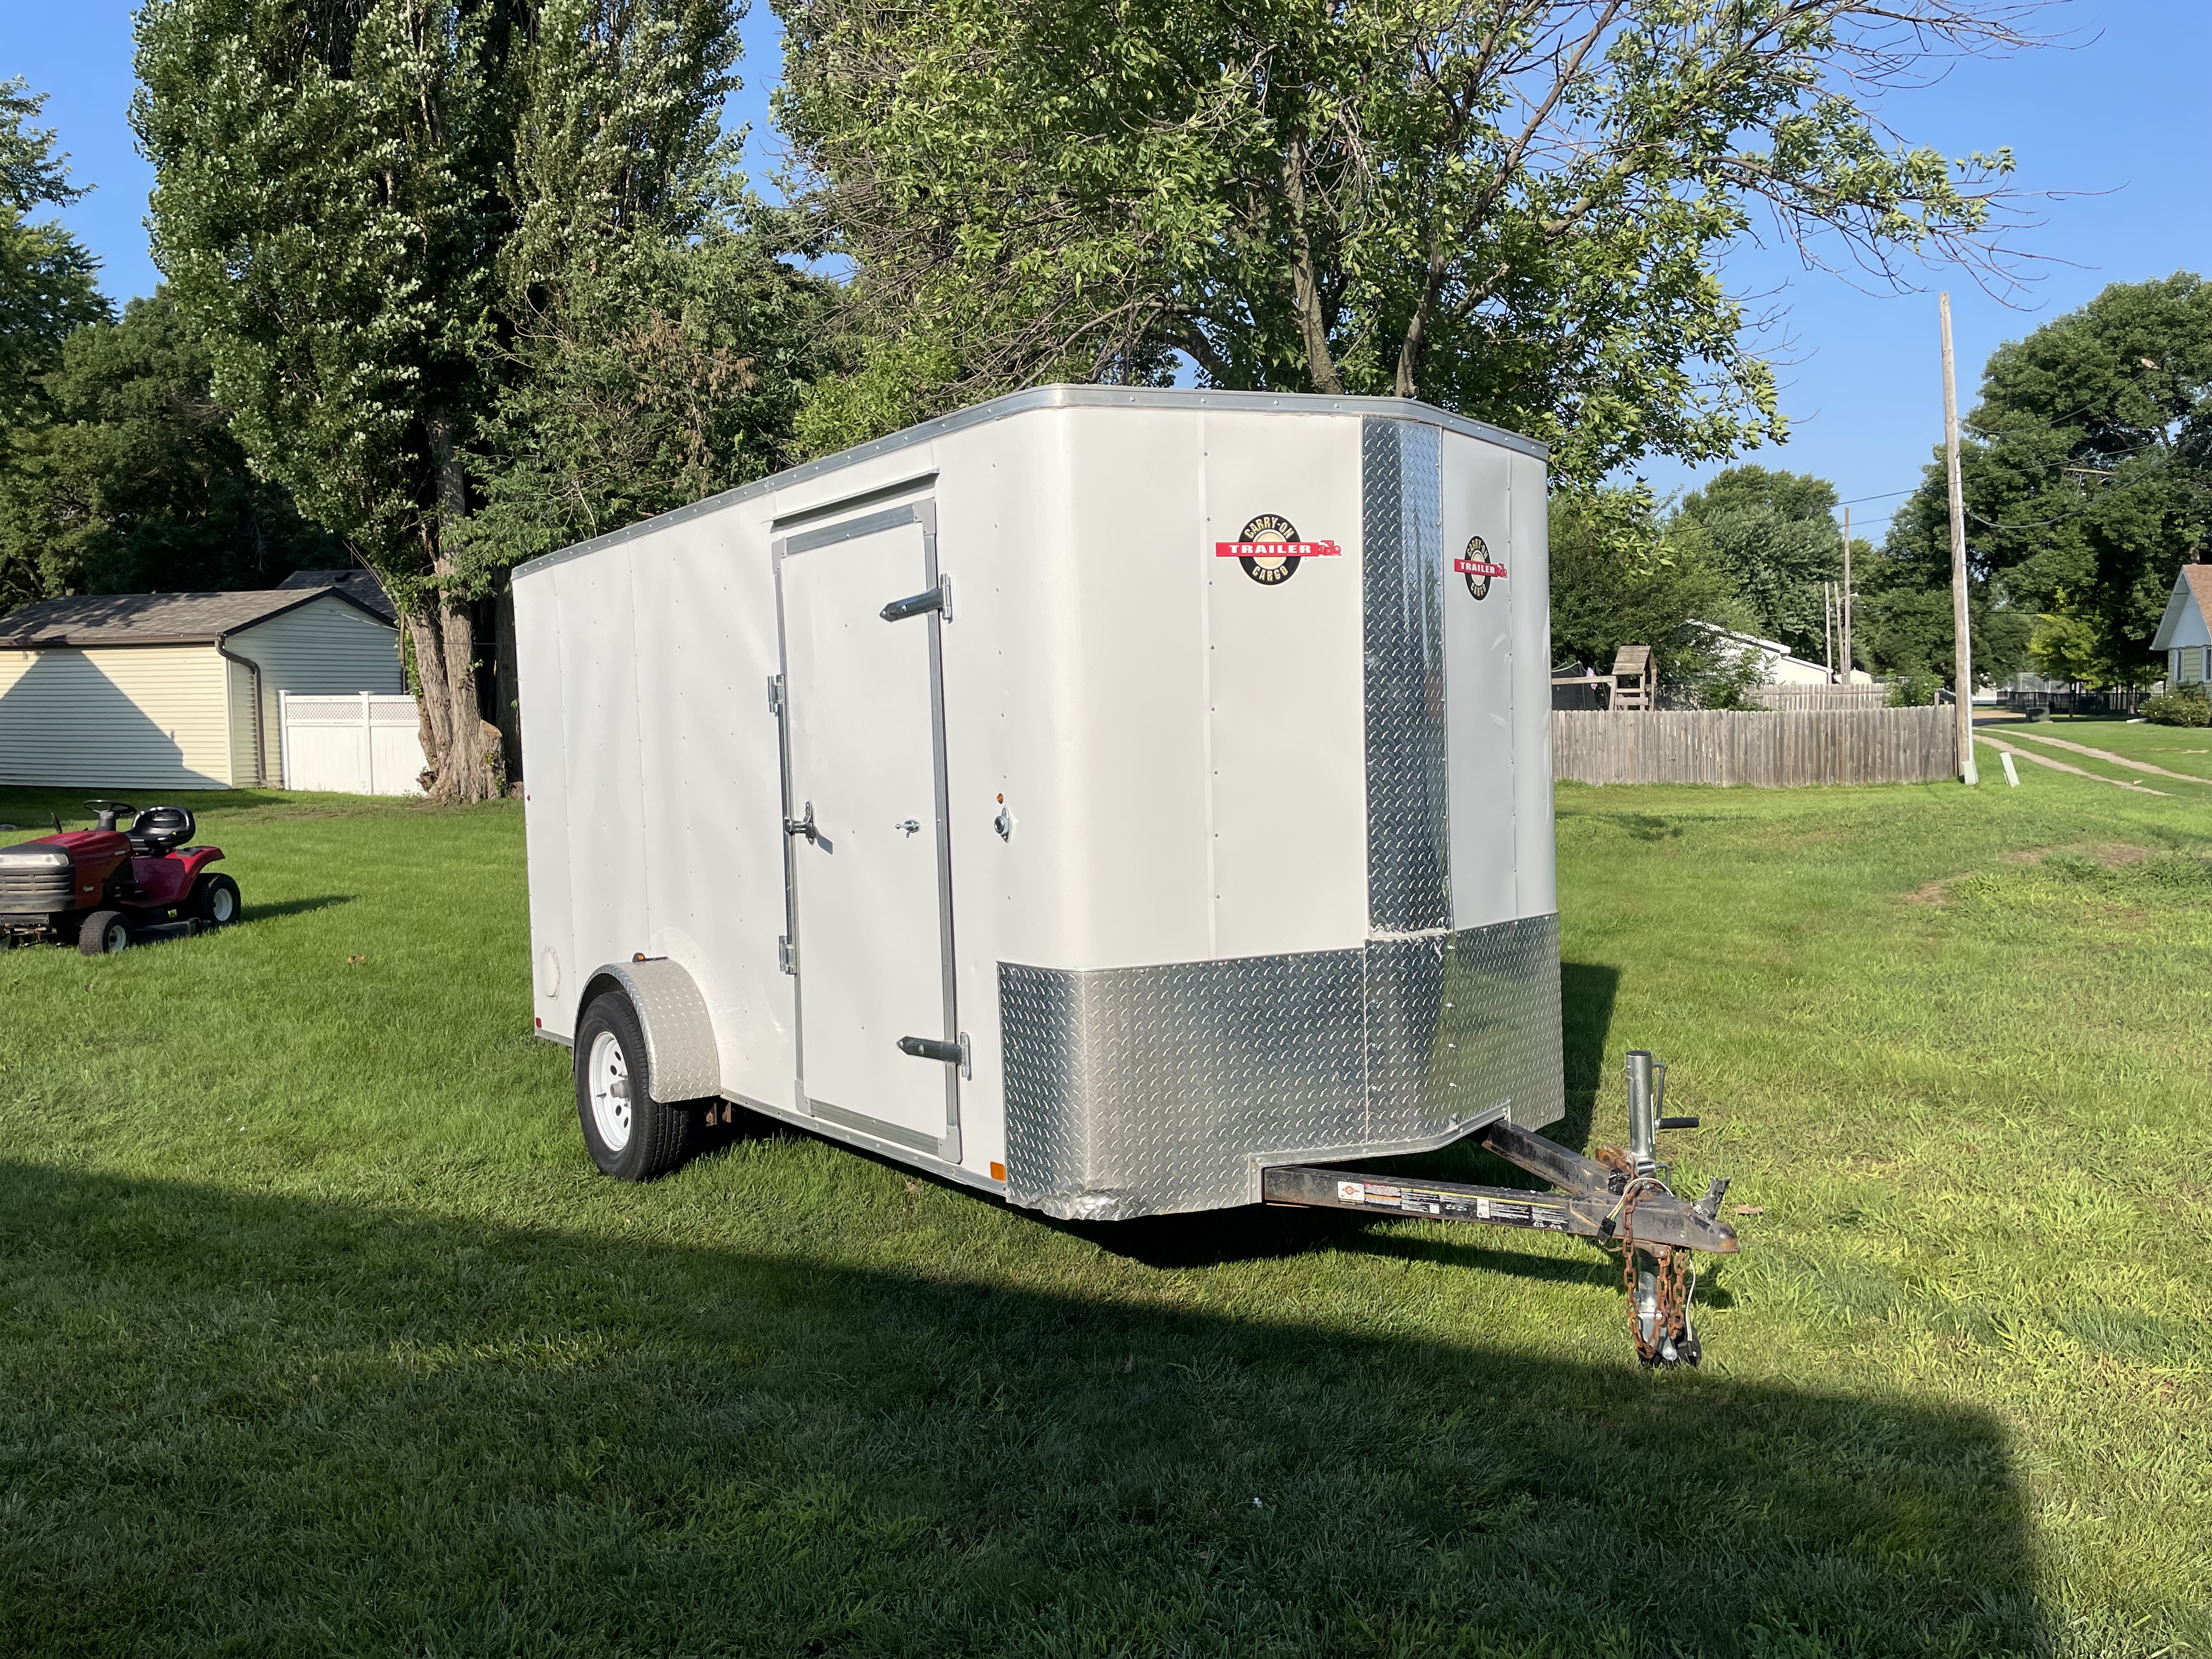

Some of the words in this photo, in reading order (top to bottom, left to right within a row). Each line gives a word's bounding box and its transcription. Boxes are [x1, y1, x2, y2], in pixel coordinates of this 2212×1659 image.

[1244, 517, 1294, 539] CARRY-ON
[1229, 545, 1311, 554] TRAILER
[1252, 566, 1288, 582] CARGO
[1460, 562, 1495, 574] TRAILER
[1470, 583, 1486, 597] CARGO
